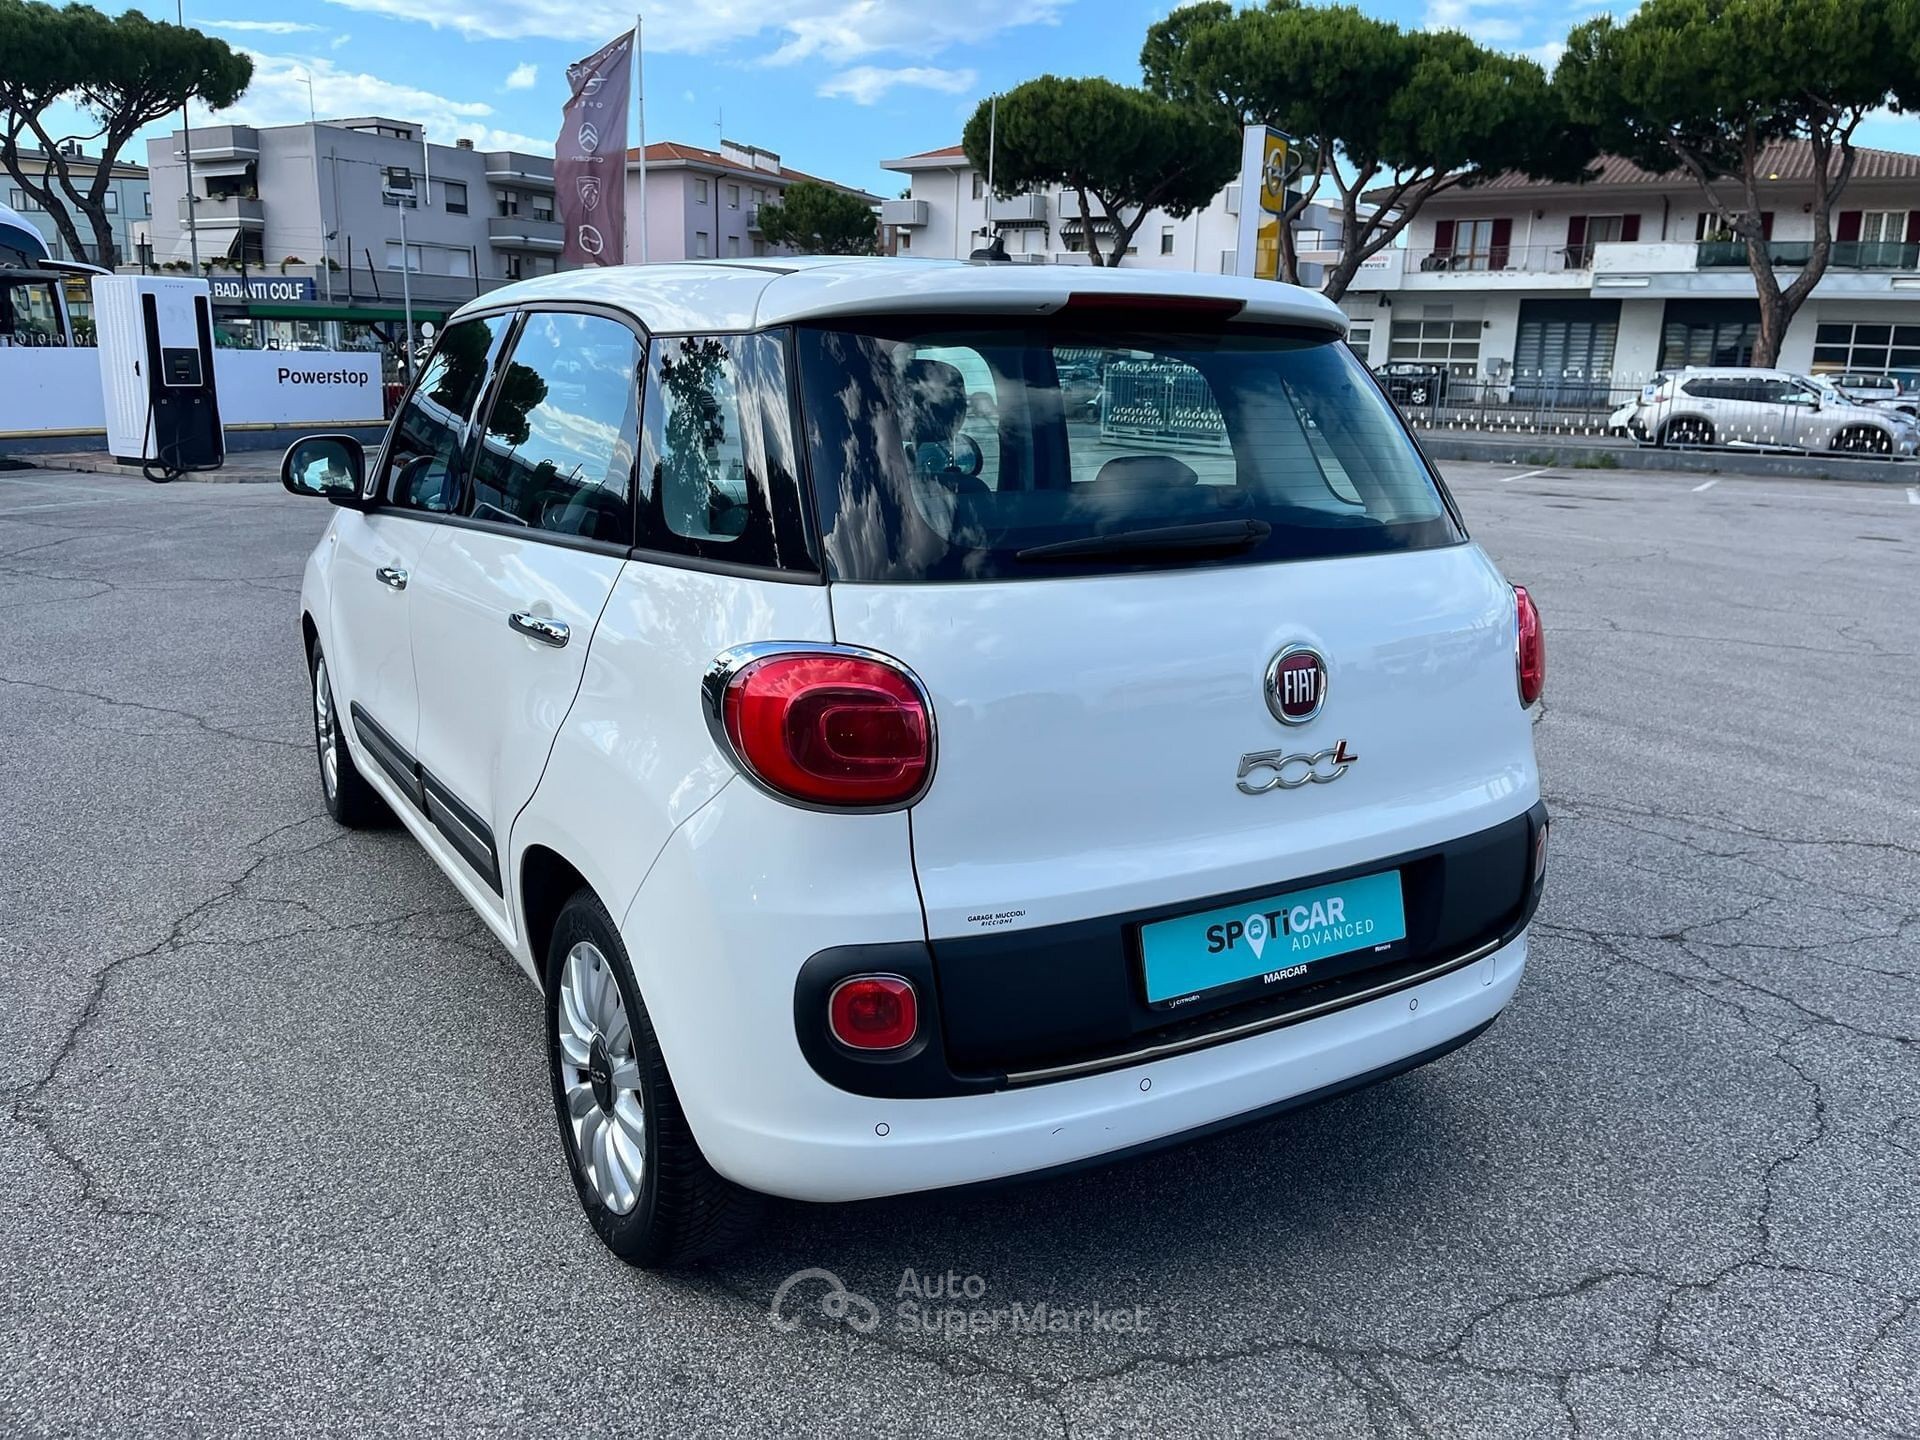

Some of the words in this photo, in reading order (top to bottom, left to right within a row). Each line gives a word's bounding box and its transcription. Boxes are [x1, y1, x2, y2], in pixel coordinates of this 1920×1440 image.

[214, 282, 268, 299] BADANTI
[270, 283, 304, 300] COLF
[278, 368, 369, 387] Powerstop
[1283, 668, 1317, 704] FIAT
[967, 913, 993, 922] GARAGE
[995, 909, 1026, 919] MUCCIOLI
[981, 918, 1013, 926] RICCIONE
[1291, 919, 1374, 952] ADVANCED
[1264, 964, 1308, 984] MARCAR
